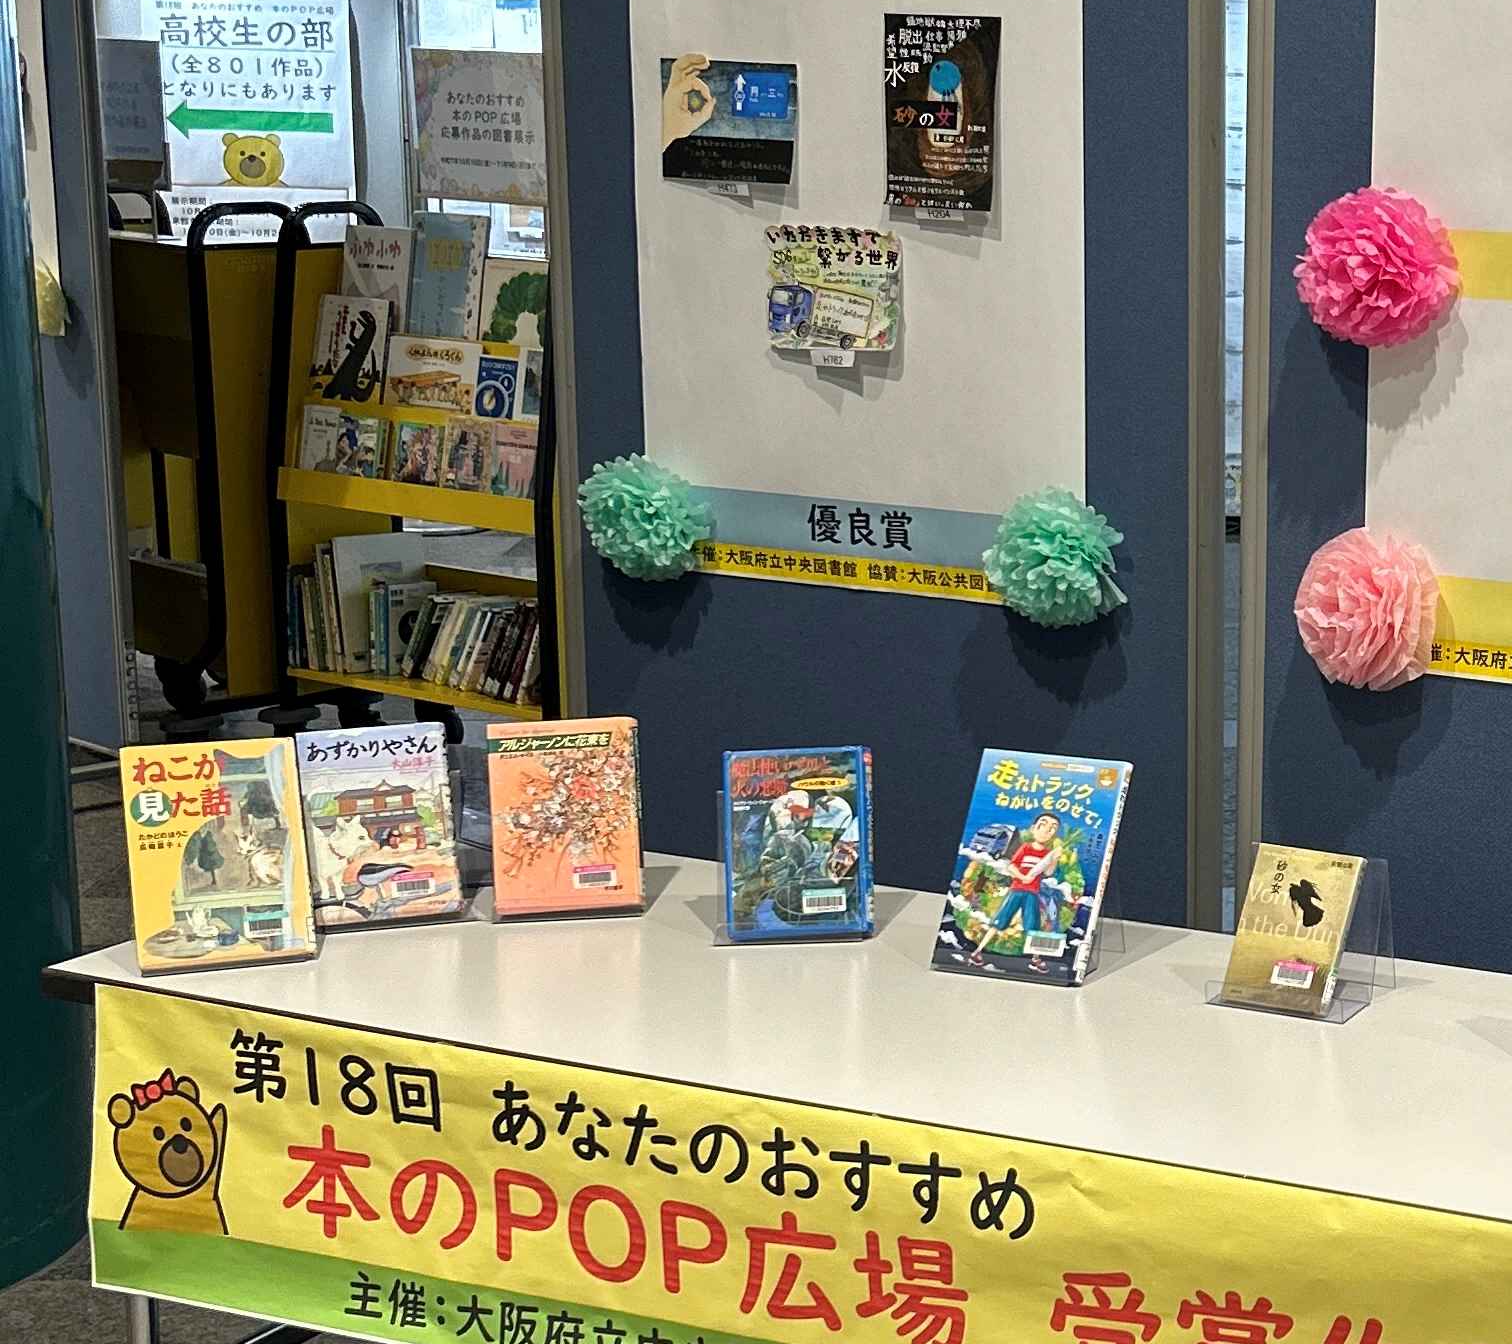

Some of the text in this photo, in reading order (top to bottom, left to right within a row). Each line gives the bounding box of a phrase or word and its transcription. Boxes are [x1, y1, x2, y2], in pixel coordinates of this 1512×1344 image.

[160, 13, 334, 50] 高校生の部
[162, 79, 337, 101] となりにもあります
[884, 60, 906, 88] 水
[447, 92, 525, 107] あなたのおすすめ
[894, 105, 954, 128] 砂の女
[817, 246, 899, 270] 繋がる世界
[807, 503, 914, 552] 優良賞
[691, 543, 858, 579] 催：大阪府立中央図書館
[306, 735, 438, 762] あずかりやさん
[498, 733, 610, 752] アルジャーノンに花束を
[132, 753, 226, 785] ねこが
[137, 787, 232, 823] 見た話
[994, 792, 1104, 829] ねがいをのせて！
[1271, 859, 1289, 895] 砂の女
[228, 1027, 1036, 1242] 第18回 あなたのおすすめ
